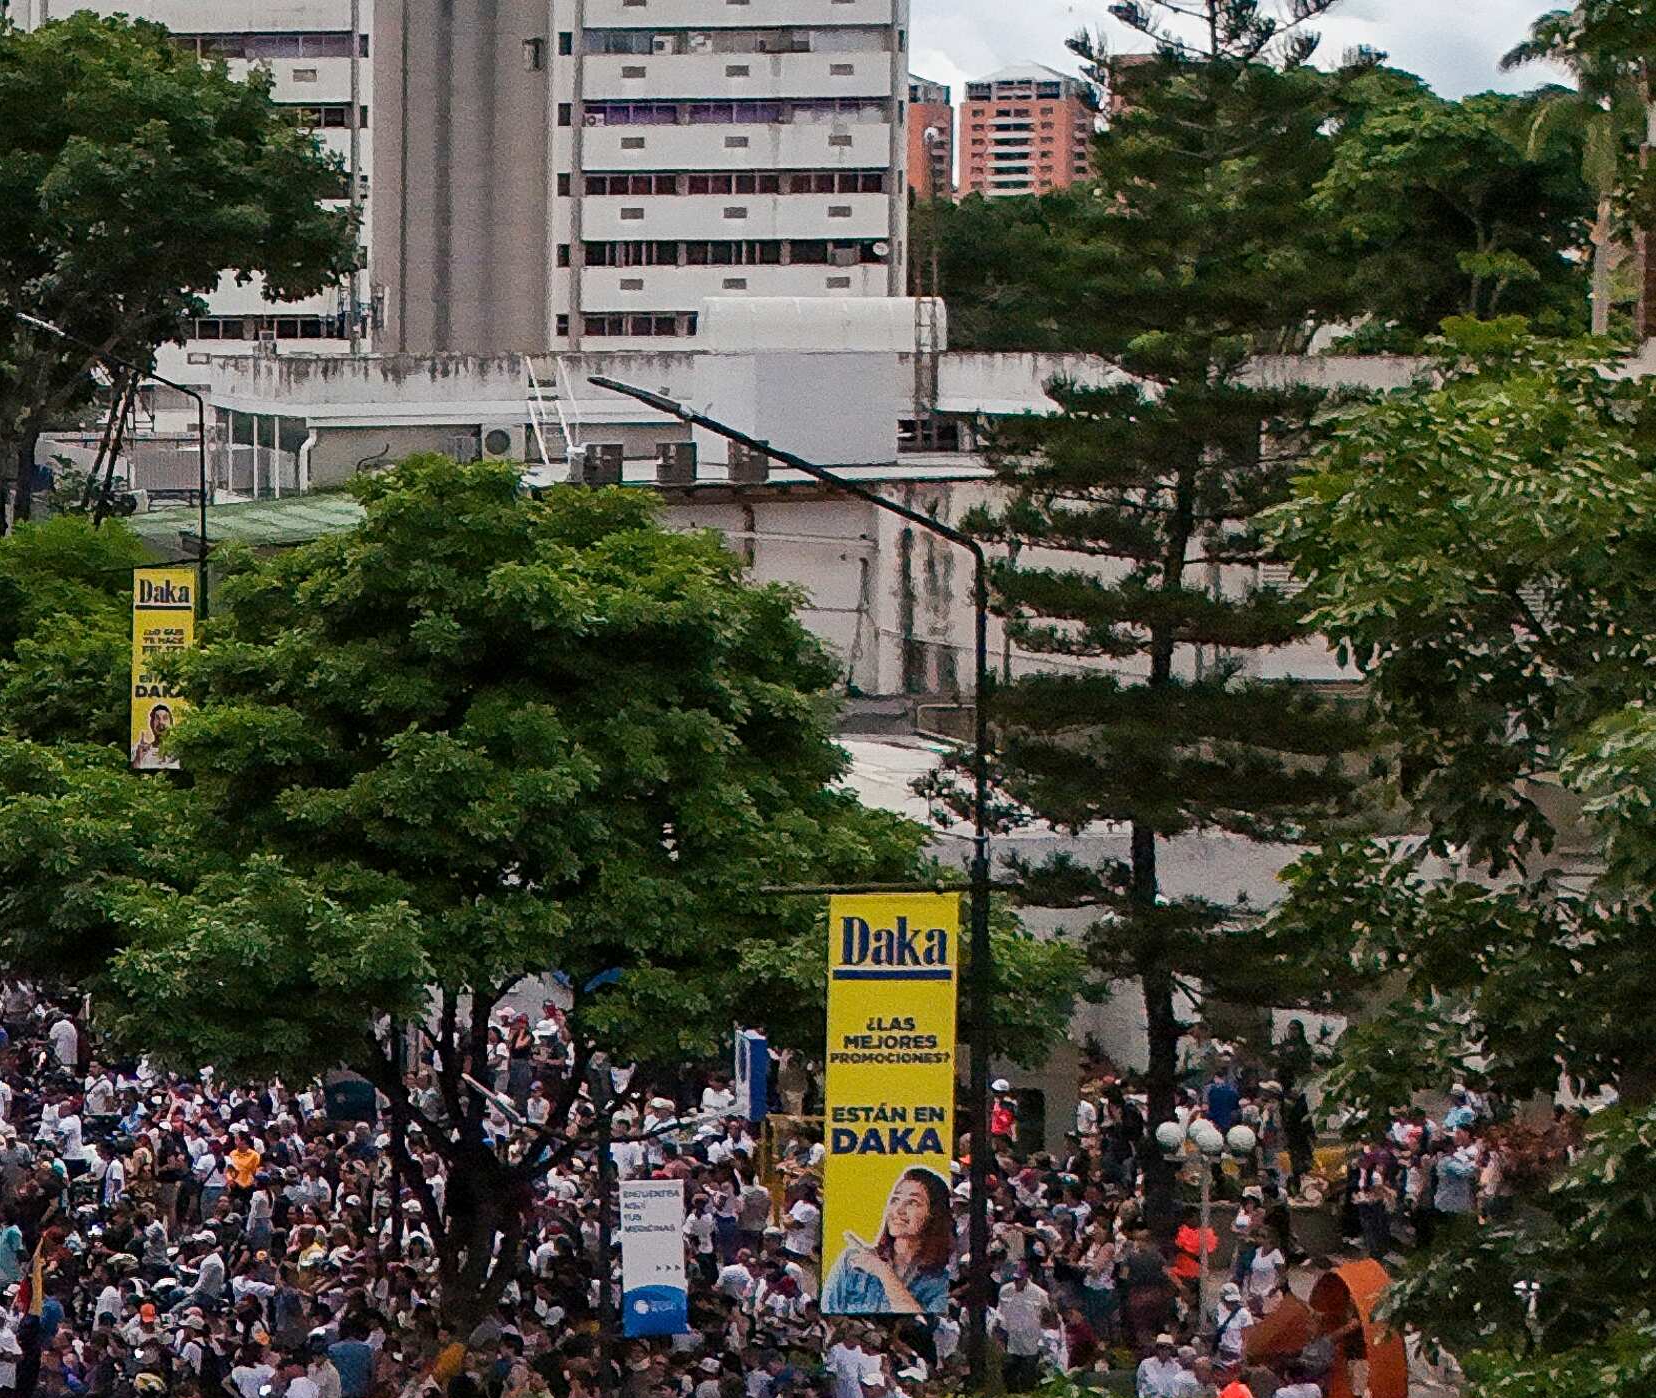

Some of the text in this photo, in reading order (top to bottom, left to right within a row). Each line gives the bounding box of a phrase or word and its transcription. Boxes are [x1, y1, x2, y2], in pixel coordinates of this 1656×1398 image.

[139, 579, 190, 603] Daka
[841, 916, 948, 966] Daka
[866, 1017, 915, 1032] ¿LAS
[843, 1035, 937, 1050] MEJORES
[830, 1052, 951, 1065] PROMOCIONES?
[831, 1102, 945, 1123] ESTÁN EN
[830, 1128, 945, 1155] DAKA
